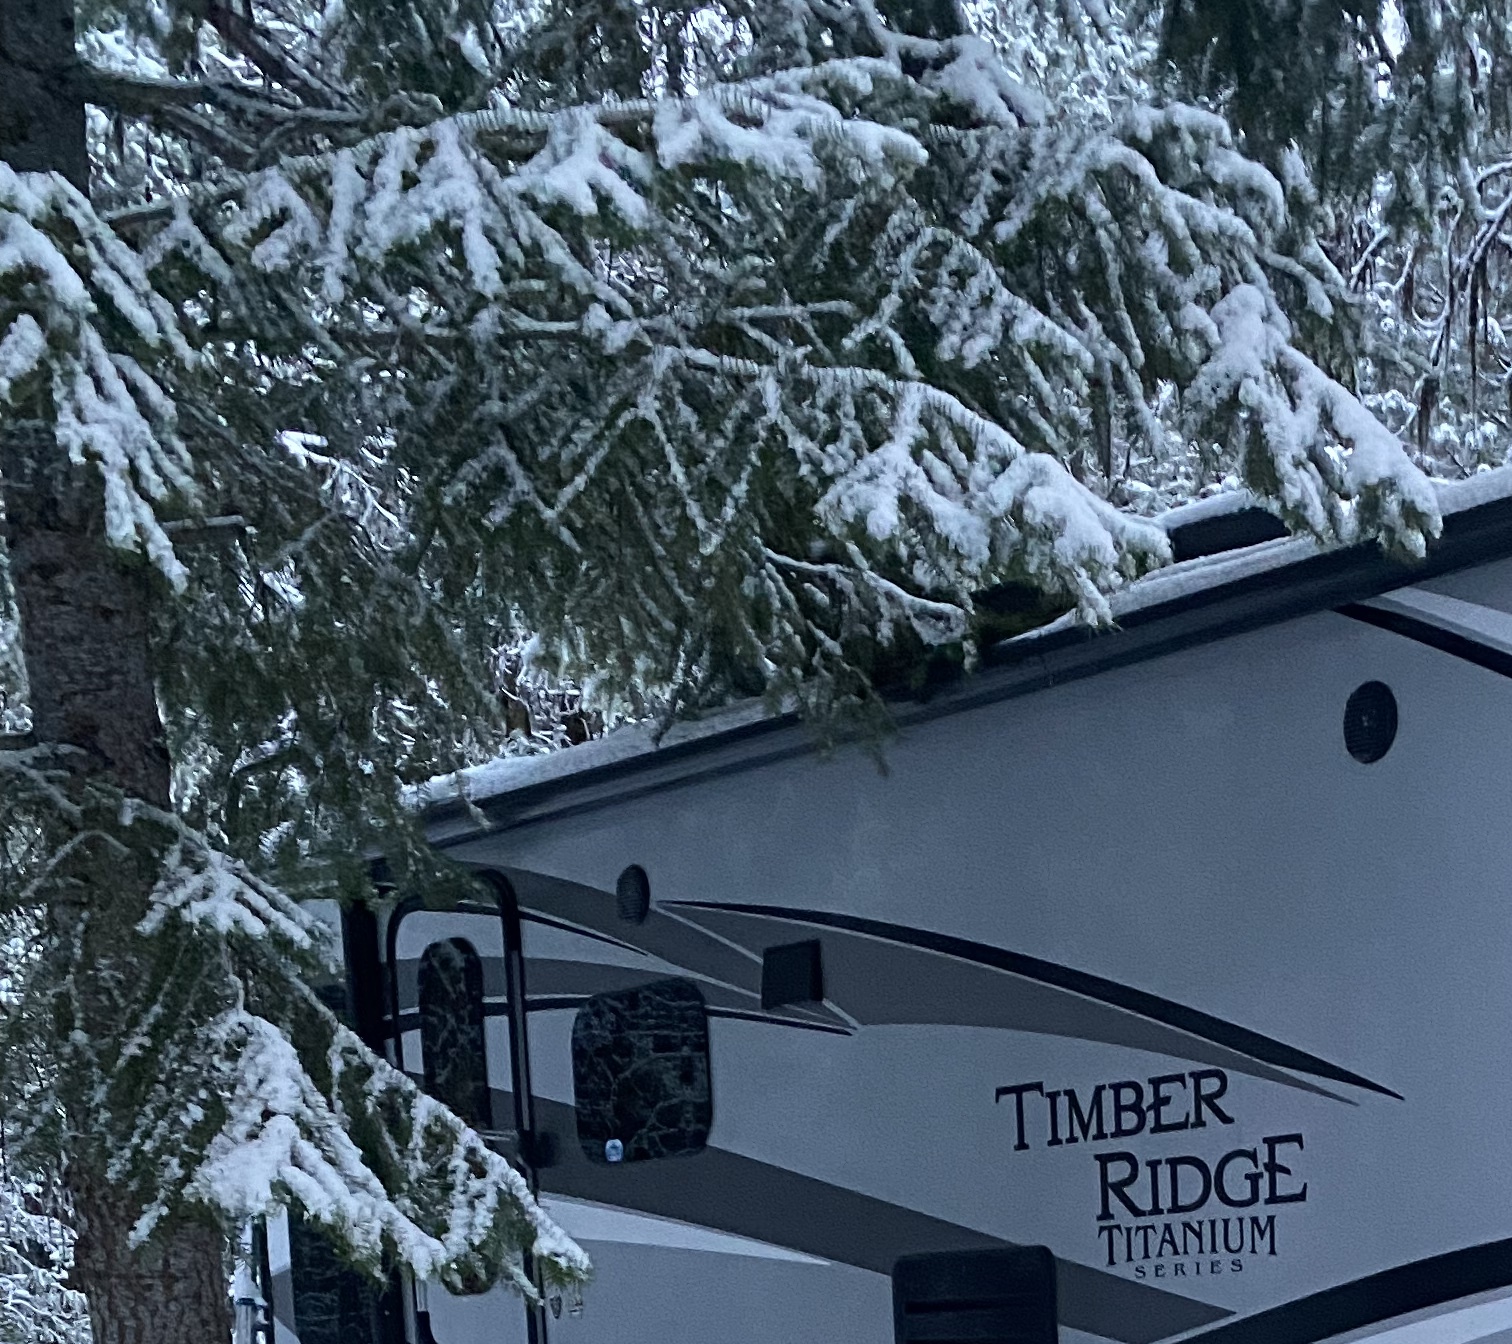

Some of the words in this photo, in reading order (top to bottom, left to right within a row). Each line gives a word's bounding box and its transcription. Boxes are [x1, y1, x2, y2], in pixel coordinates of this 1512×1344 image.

[995, 1068, 1235, 1151] TIMBER
[1093, 1133, 1308, 1222] RIDGE
[1097, 1215, 1277, 1267] TITANIUM
[1135, 1258, 1244, 1279] SERIES
